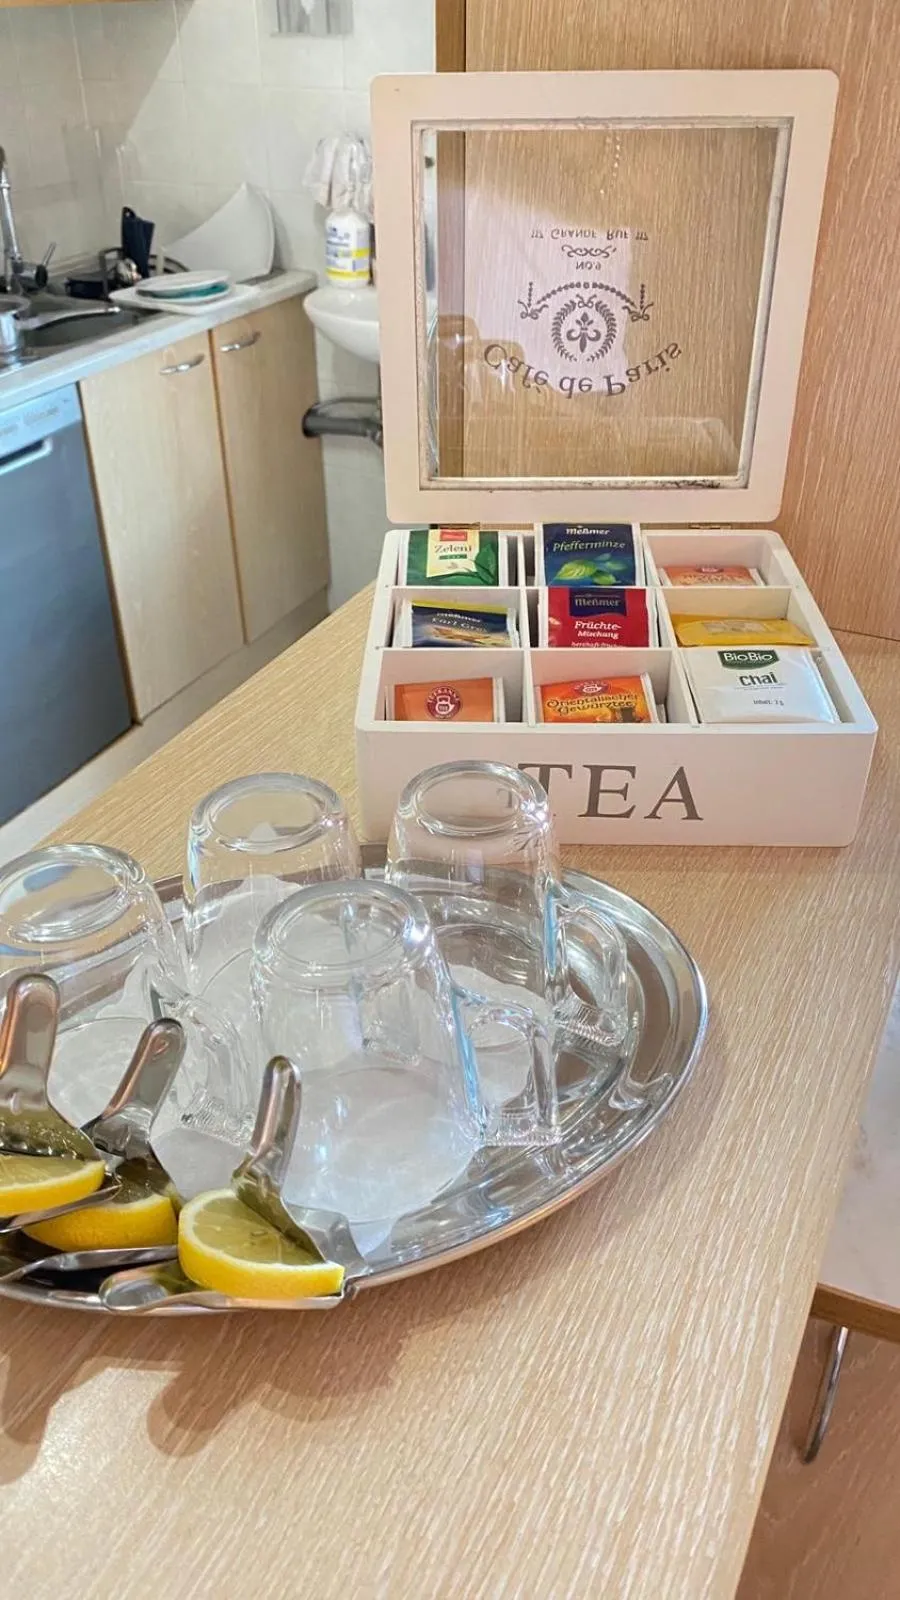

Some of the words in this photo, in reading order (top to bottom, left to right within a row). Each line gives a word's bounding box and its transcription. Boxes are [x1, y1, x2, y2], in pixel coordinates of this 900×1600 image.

[553, 540, 626, 552] Pfefferminze
[574, 620, 622, 630] Früchte-
[723, 652, 773, 662] BioBio
[517, 763, 704, 821] TEA
